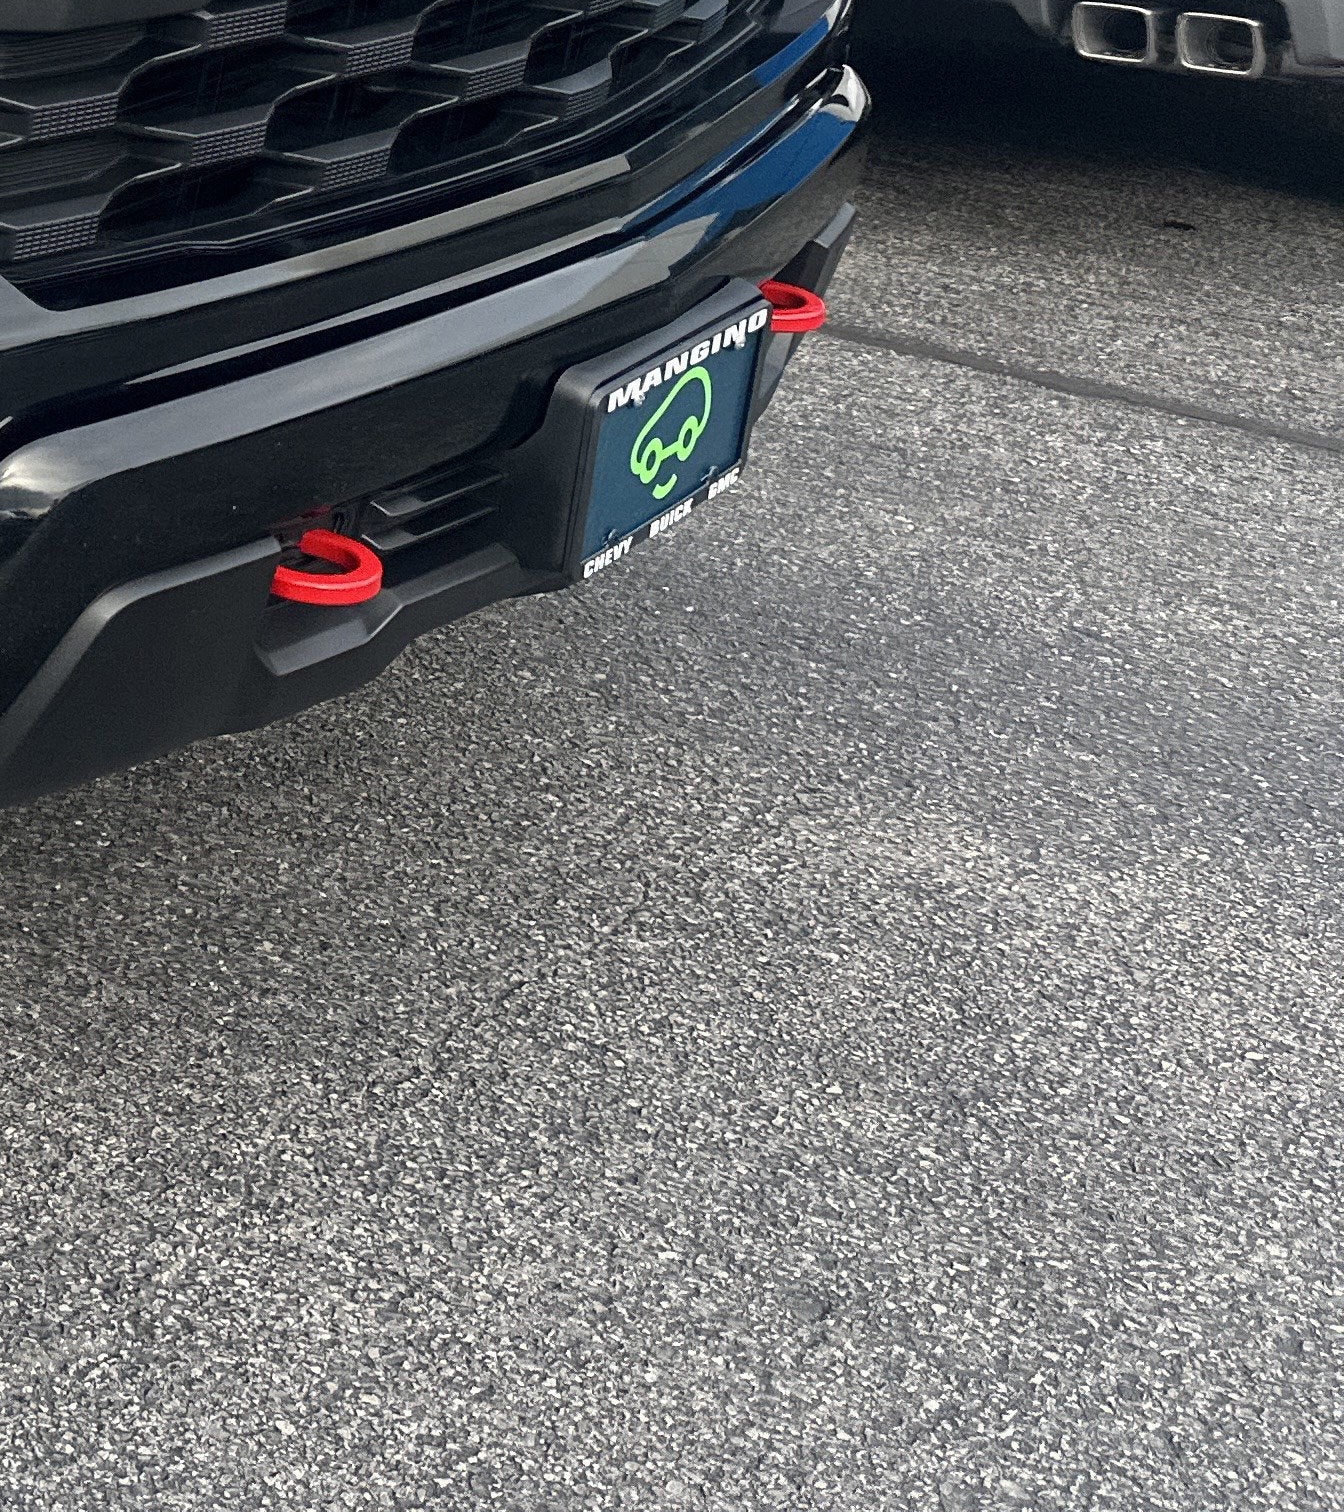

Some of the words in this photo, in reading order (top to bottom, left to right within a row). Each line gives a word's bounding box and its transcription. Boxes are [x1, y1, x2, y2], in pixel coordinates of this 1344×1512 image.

[607, 308, 769, 413] MANGINO
[583, 536, 633, 579] CHEVY
[649, 497, 694, 539] BUICK
[707, 467, 740, 500] GMC
